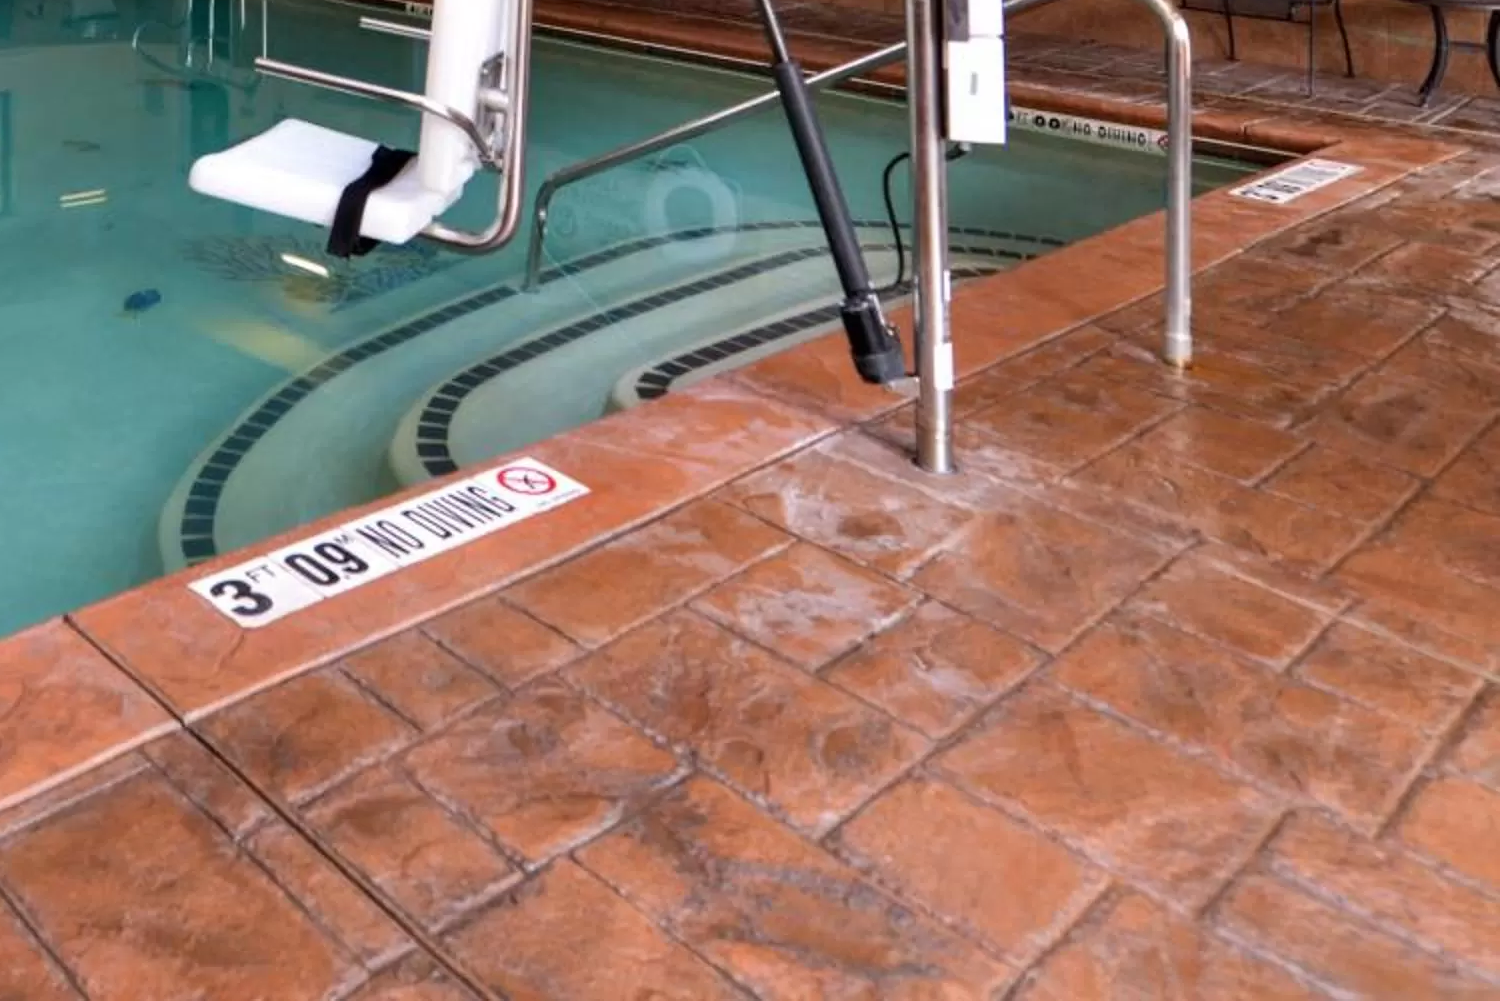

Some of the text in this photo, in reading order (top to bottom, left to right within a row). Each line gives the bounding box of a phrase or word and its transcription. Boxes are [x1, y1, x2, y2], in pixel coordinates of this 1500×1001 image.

[210, 579, 273, 616] 3
[245, 564, 276, 583] FT
[355, 519, 425, 559] NO
[401, 486, 517, 540] DIVING
